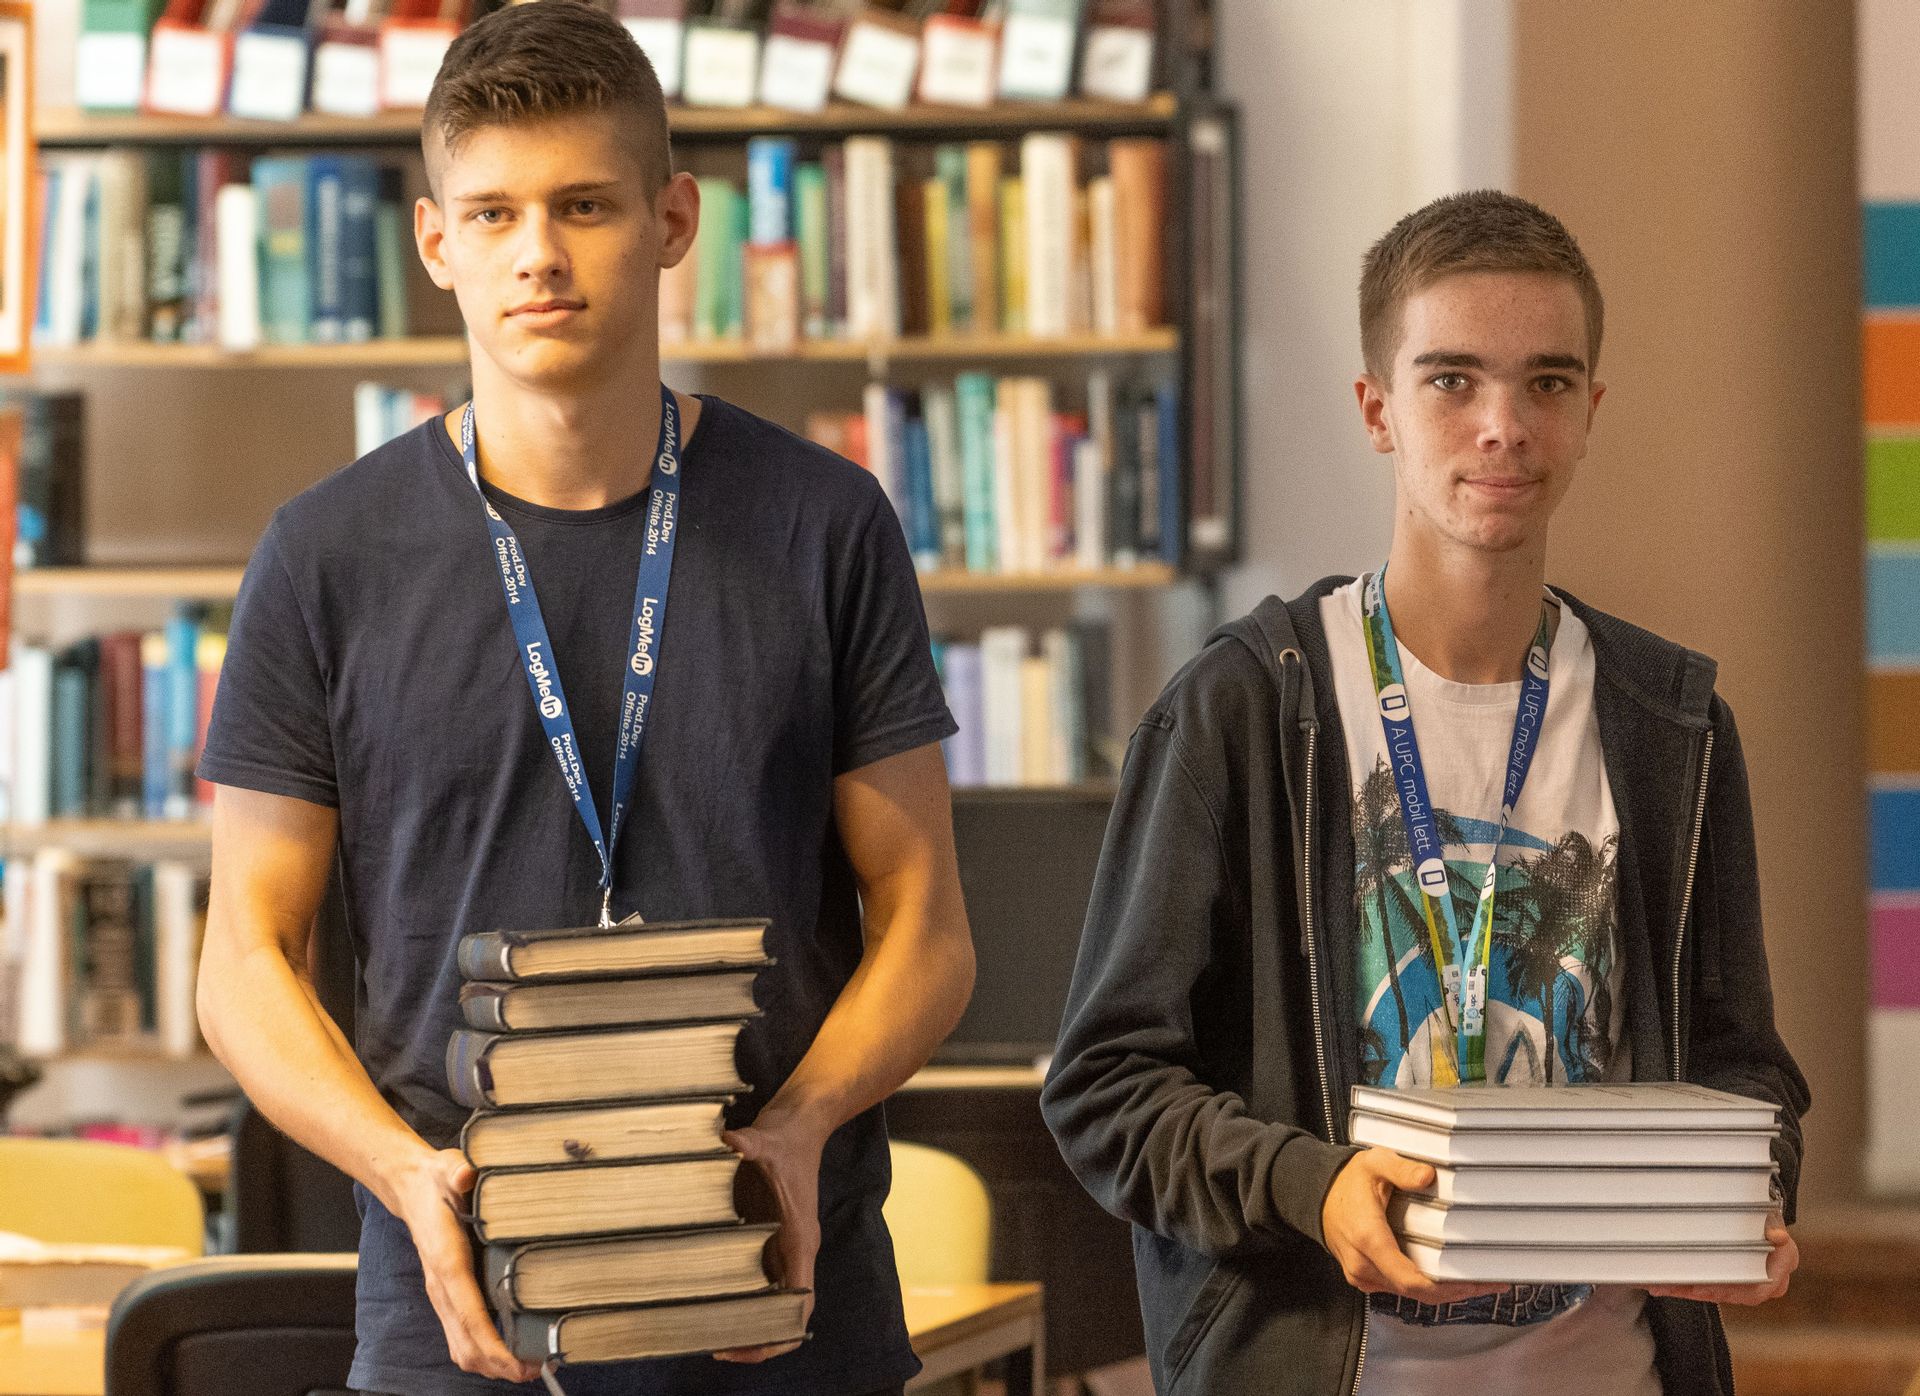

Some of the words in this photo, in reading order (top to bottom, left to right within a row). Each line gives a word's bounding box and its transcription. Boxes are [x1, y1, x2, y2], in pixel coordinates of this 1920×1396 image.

[658, 402, 678, 475] LogMeIn
[646, 489, 664, 555] Offsite.2014
[661, 492, 676, 543] Prod.Dev
[495, 538, 520, 605] Offsite.2014
[506, 536, 527, 587] Prod.Dev
[631, 597, 658, 676] LogMeIn
[526, 641, 563, 719] LogMeIn
[1528, 679, 1542, 692] A
[619, 691, 636, 760] Offsite.2014
[630, 694, 648, 748] Prod.Dev
[1391, 727, 1407, 740] A
[1522, 692, 1540, 726] UPC
[551, 737, 581, 802] Offsite.2014
[560, 732, 582, 786] Prod.Dev
[1395, 741, 1416, 775] UPC
[1511, 727, 1530, 770] mobil
[1403, 780, 1427, 822] mobil
[1413, 823, 1432, 855] lett.
